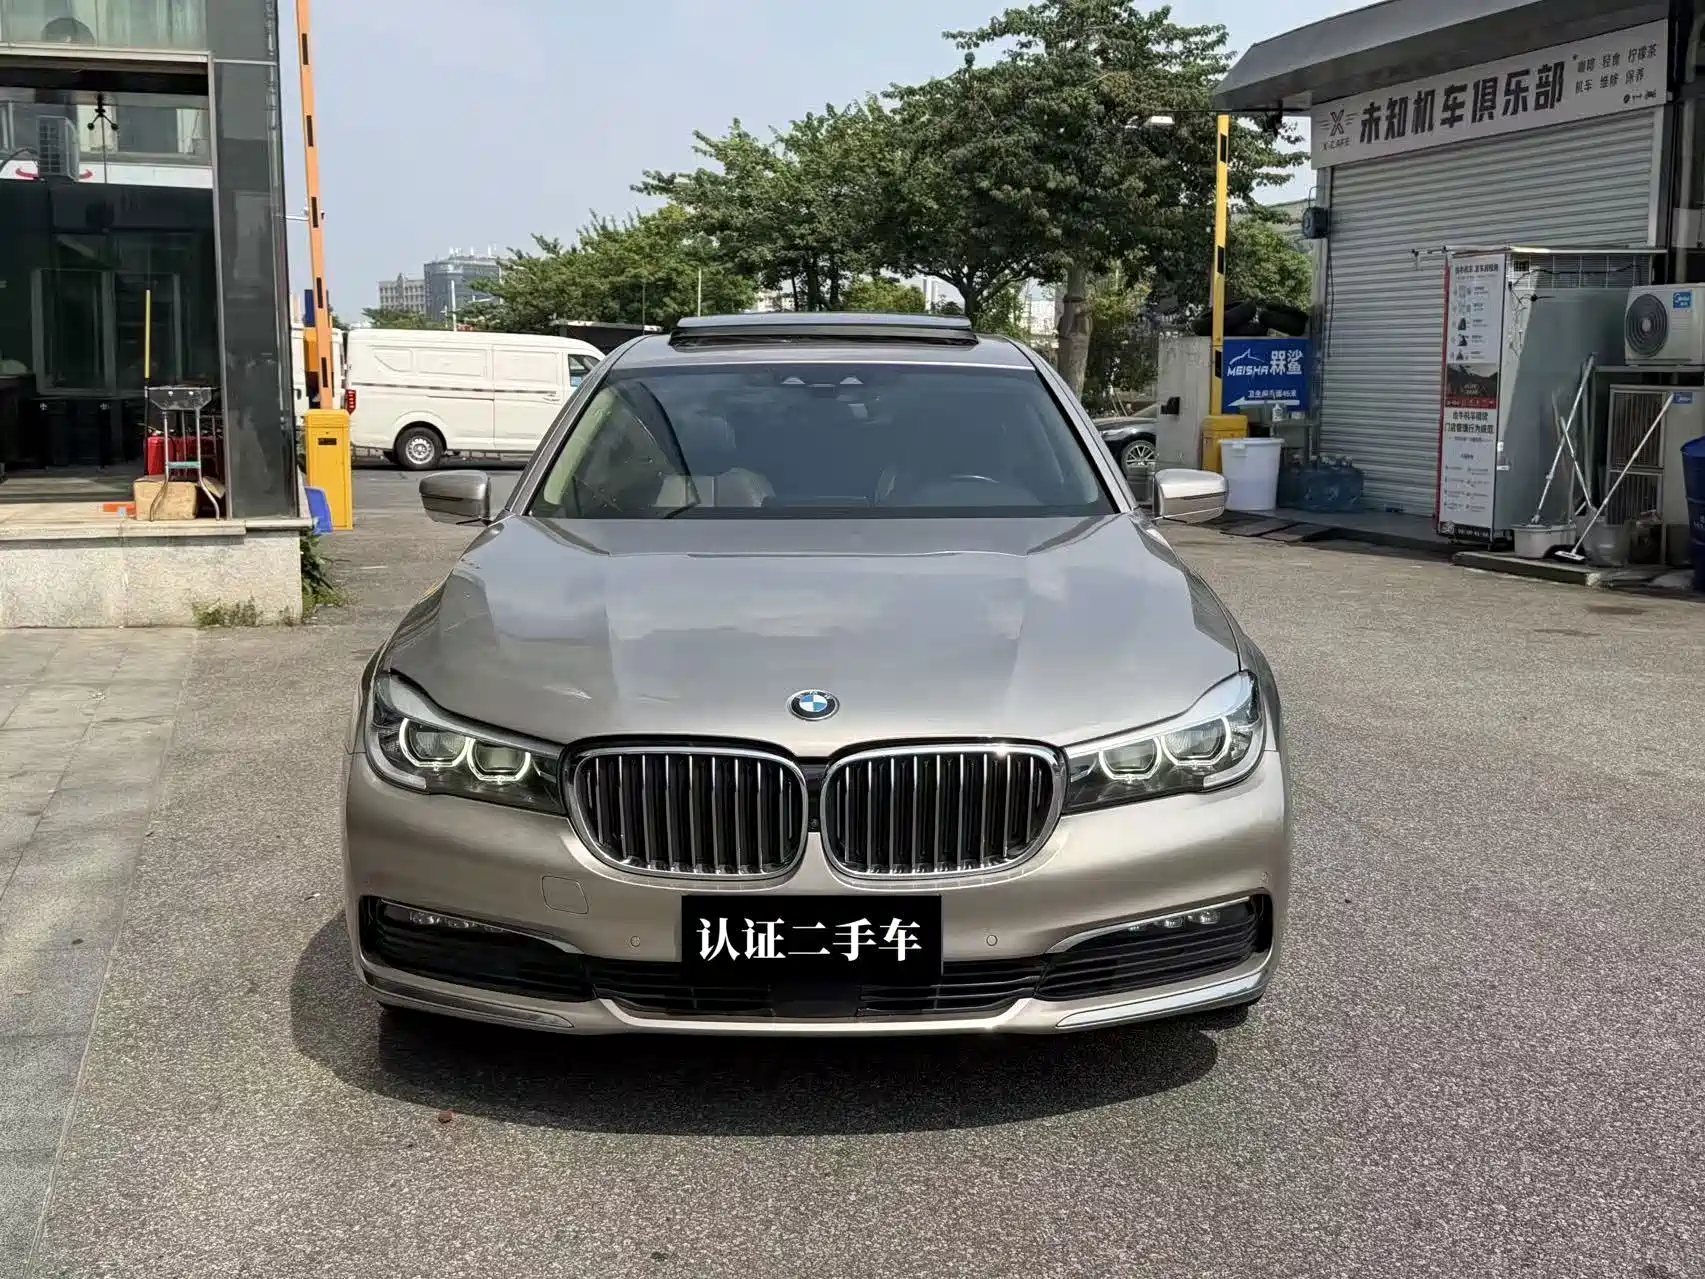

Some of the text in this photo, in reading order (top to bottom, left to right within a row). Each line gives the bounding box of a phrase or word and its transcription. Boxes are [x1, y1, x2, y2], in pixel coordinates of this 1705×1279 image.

[1625, 67, 1644, 84] 保养
[1359, 61, 1565, 144] 未知机车俱乐部
[1227, 365, 1269, 378] MEISHA
